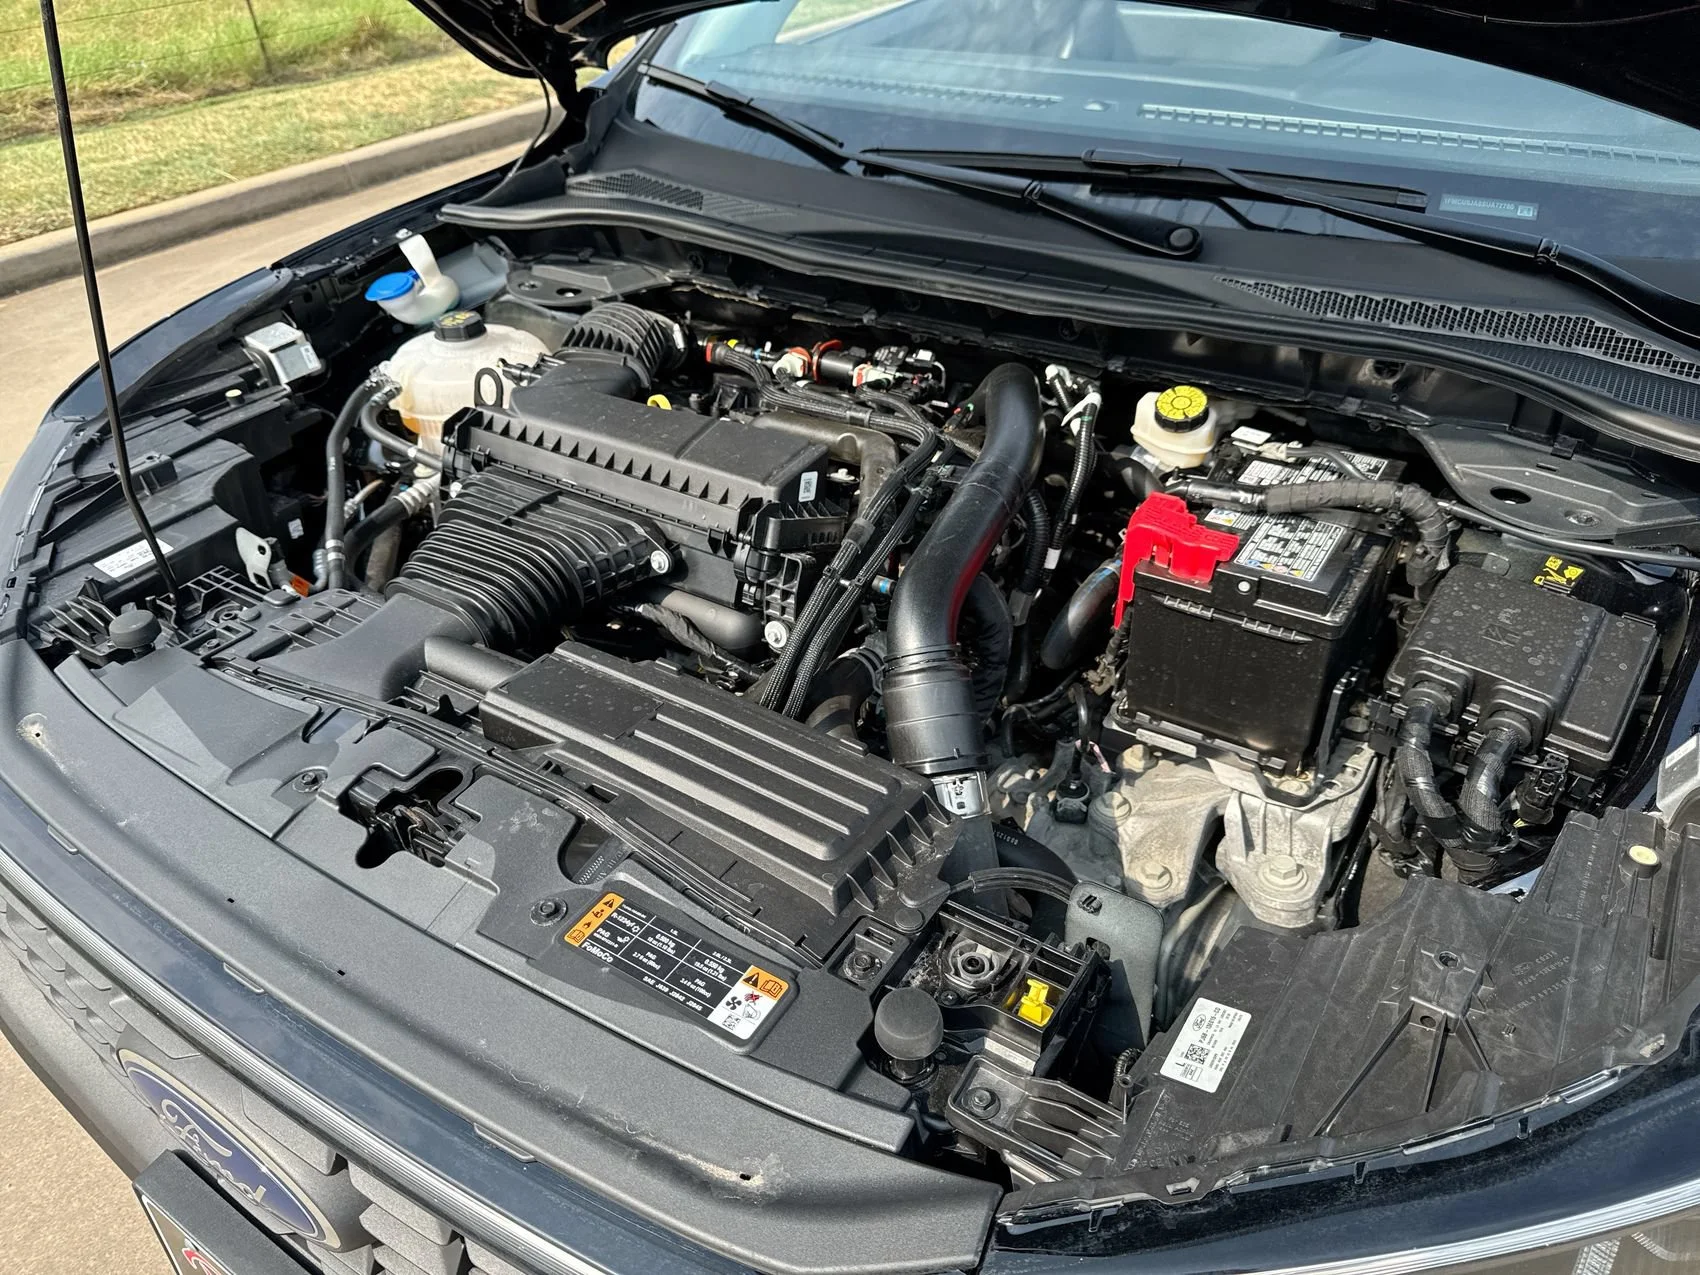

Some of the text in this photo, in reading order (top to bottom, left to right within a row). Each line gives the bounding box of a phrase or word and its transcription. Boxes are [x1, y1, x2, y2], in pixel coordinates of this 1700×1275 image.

[596, 927, 611, 937] PAG
[581, 942, 614, 963] FoMoCo
[644, 951, 657, 960] PAG
[693, 978, 706, 987] PAG
